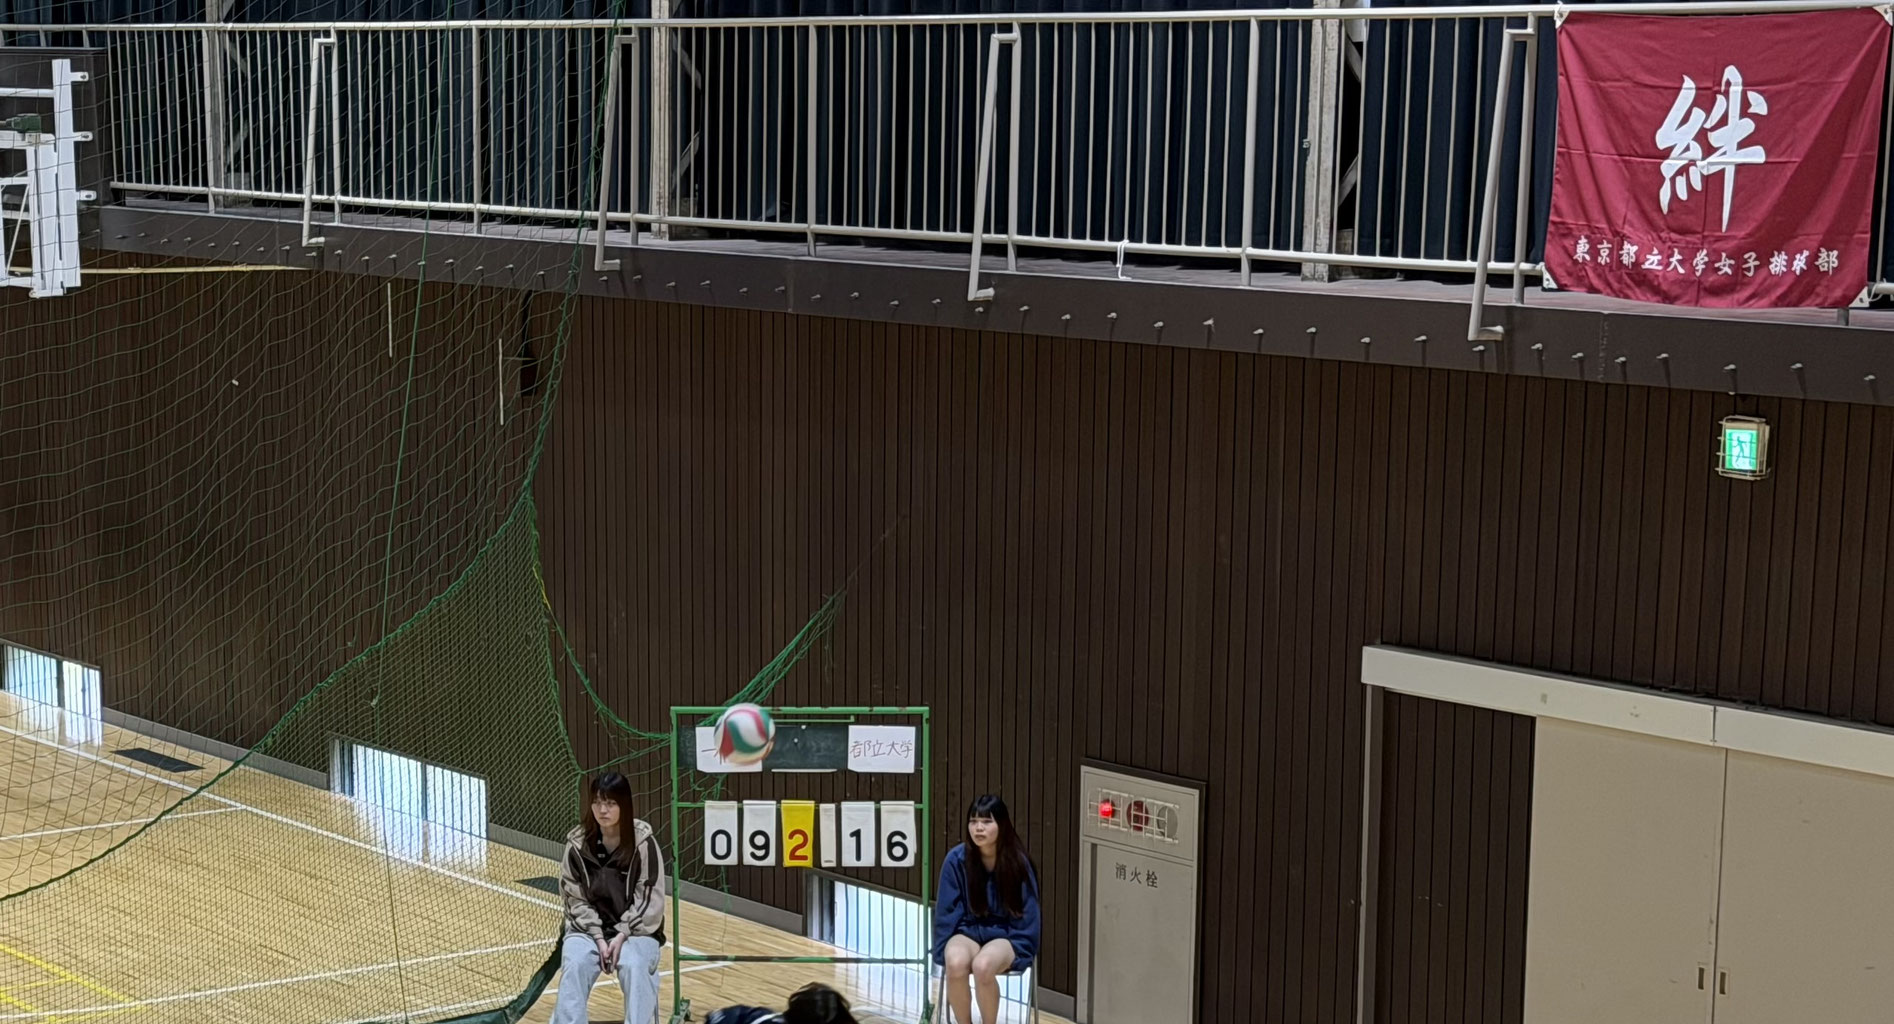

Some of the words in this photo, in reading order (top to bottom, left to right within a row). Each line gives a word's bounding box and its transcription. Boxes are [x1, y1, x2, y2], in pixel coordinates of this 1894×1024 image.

[1655, 65, 1768, 233] 絆
[850, 739, 913, 759] 都立大学
[787, 828, 810, 862] 2
[1115, 862, 1158, 889] 消火栓
